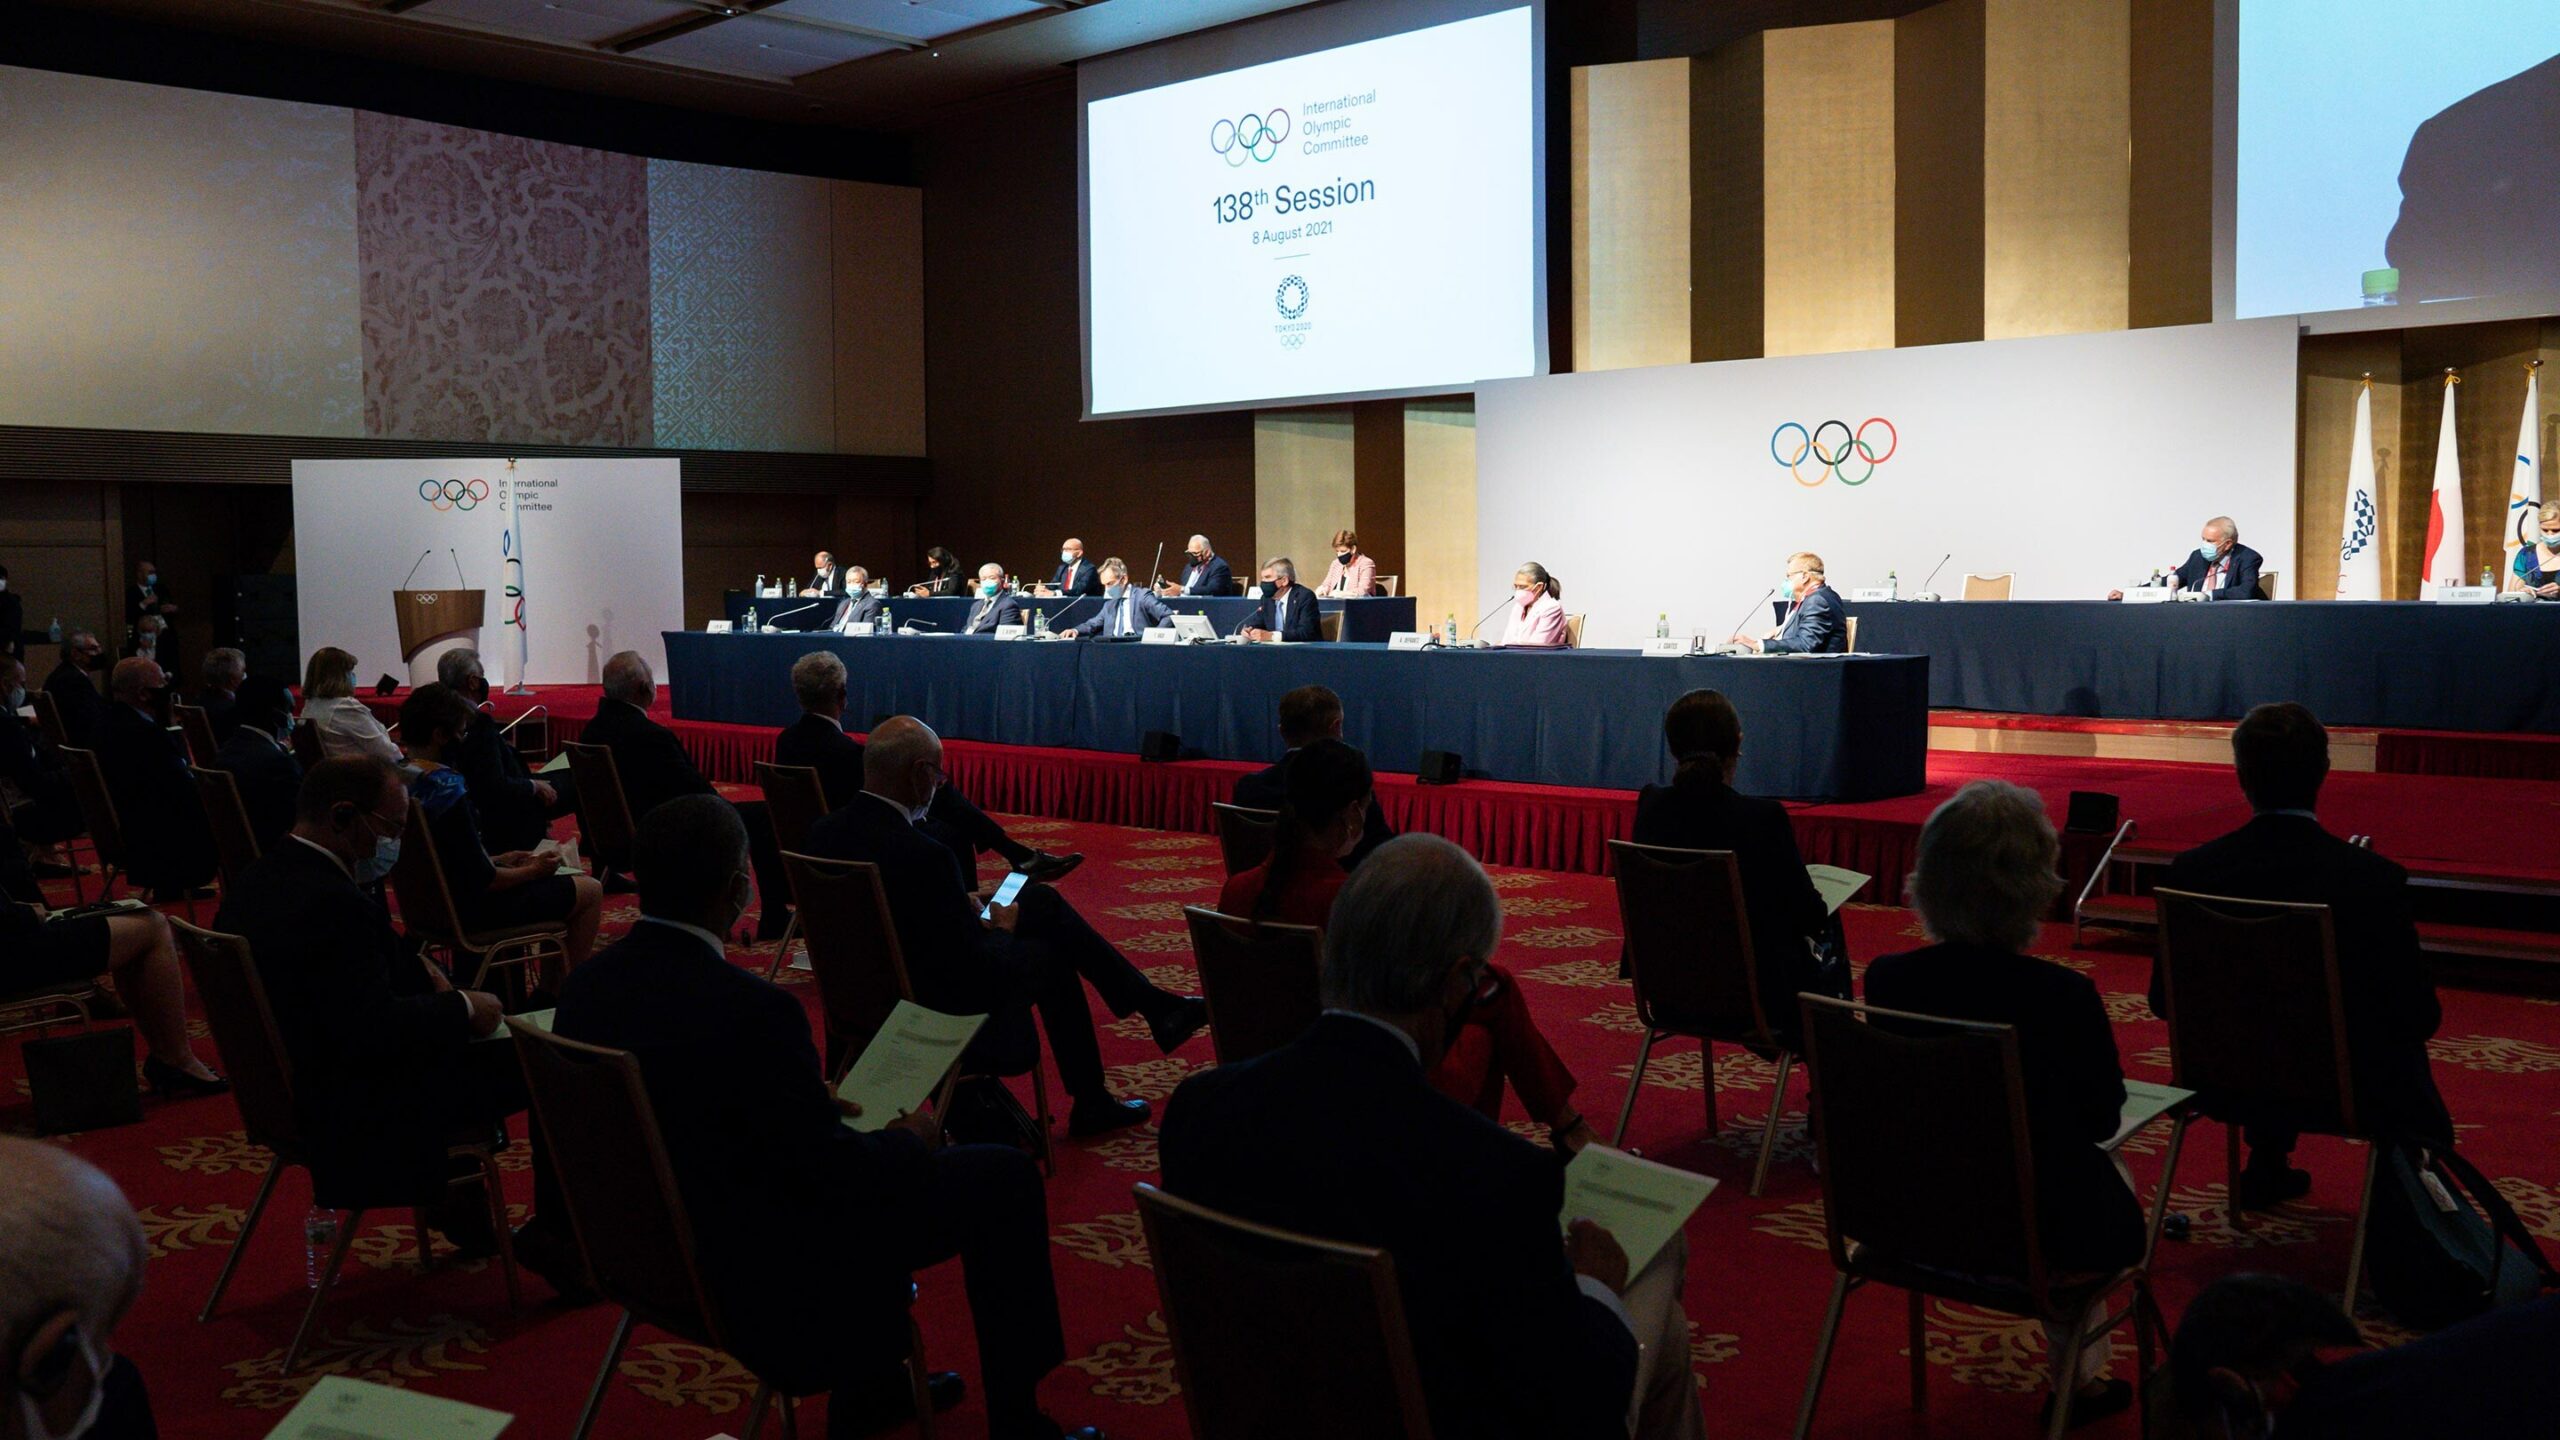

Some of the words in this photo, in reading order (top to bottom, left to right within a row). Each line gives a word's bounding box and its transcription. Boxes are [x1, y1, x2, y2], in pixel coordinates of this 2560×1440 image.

[1303, 89, 1376, 116] International
[1303, 116, 1352, 137] Olympic
[1303, 134, 1369, 155] Committee
[1213, 188, 1269, 224] 138th
[1275, 177, 1375, 214] Session
[1252, 231, 1260, 245] 8
[1262, 227, 1302, 245] August
[1306, 220, 1333, 237] 2021
[498, 479, 558, 488] Inrnational
[499, 489, 539, 501] Ompic
[499, 501, 553, 511] Cmmittee
